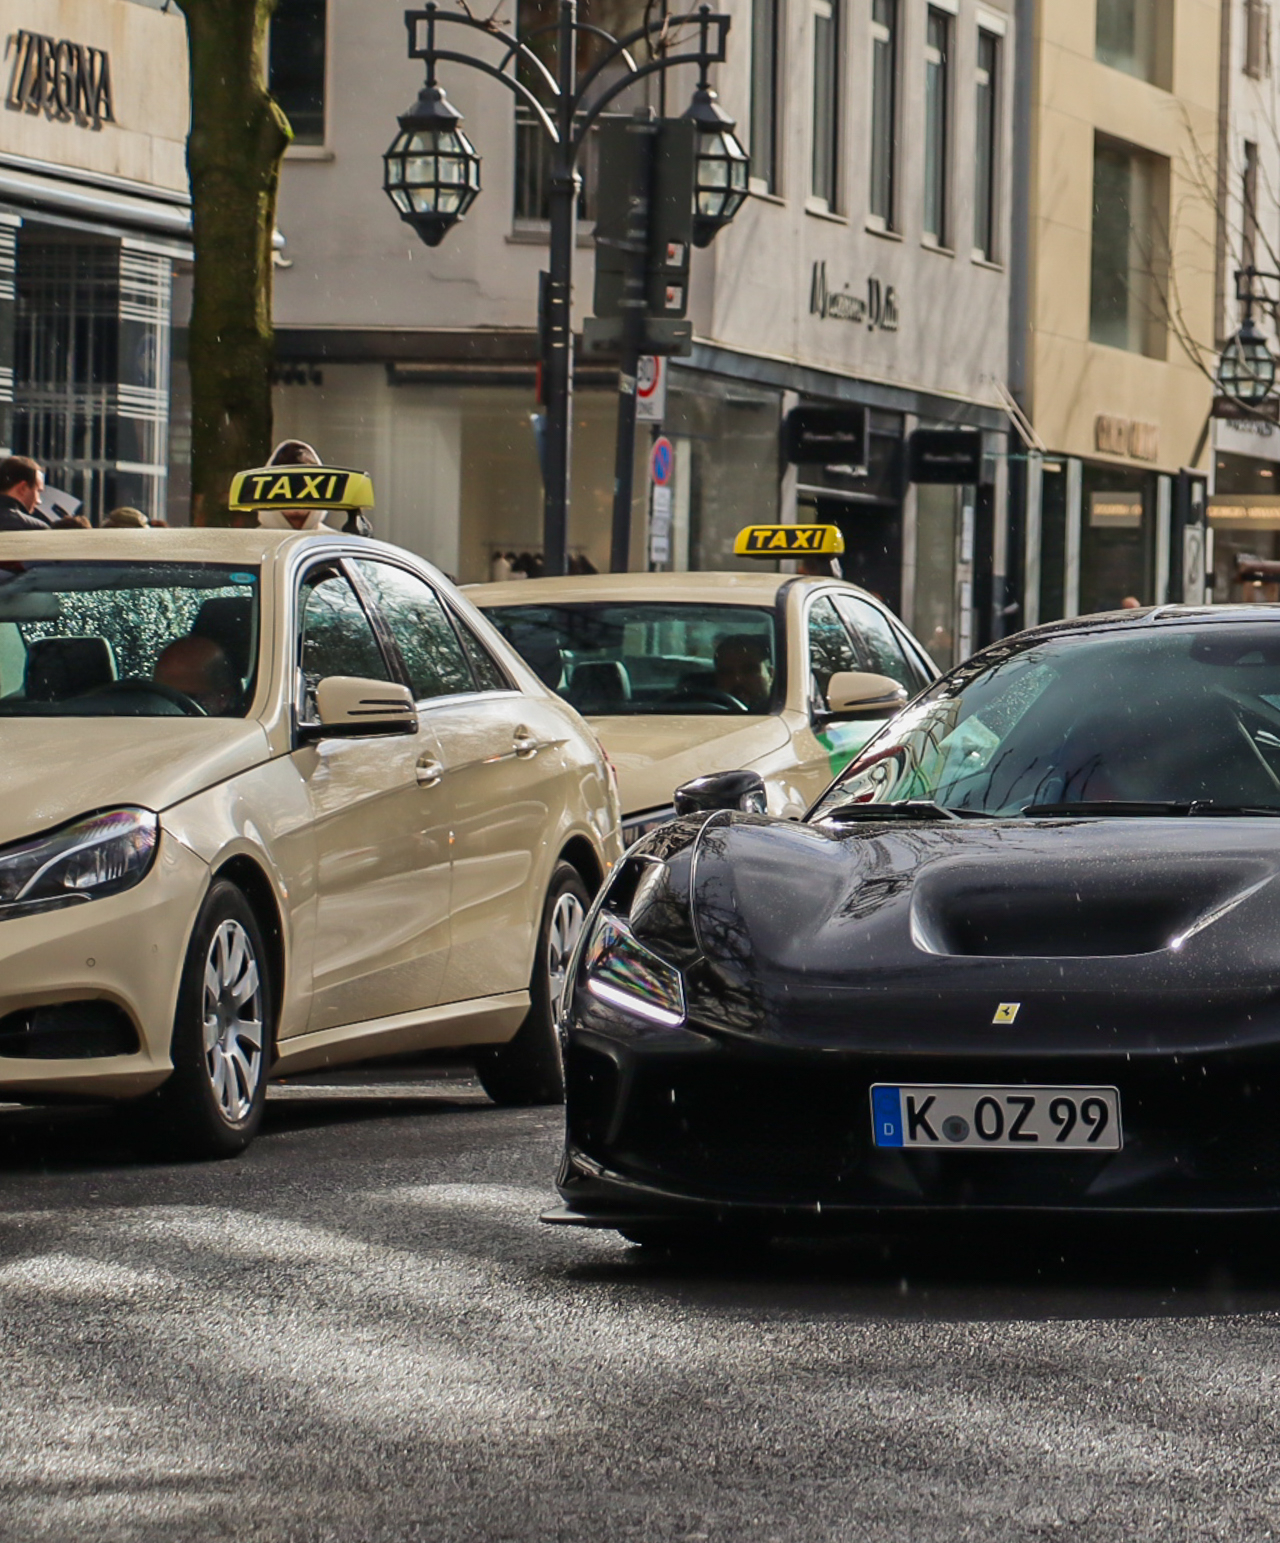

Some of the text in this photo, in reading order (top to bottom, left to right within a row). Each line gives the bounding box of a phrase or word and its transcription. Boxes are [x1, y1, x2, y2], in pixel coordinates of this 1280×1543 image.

[6, 28, 115, 130] ZEGNA
[252, 475, 338, 499] TAXI
[753, 530, 822, 548] TAXI
[906, 1096, 939, 1141] K
[974, 1096, 1039, 1142] OZ
[1049, 1097, 1109, 1142] 99
